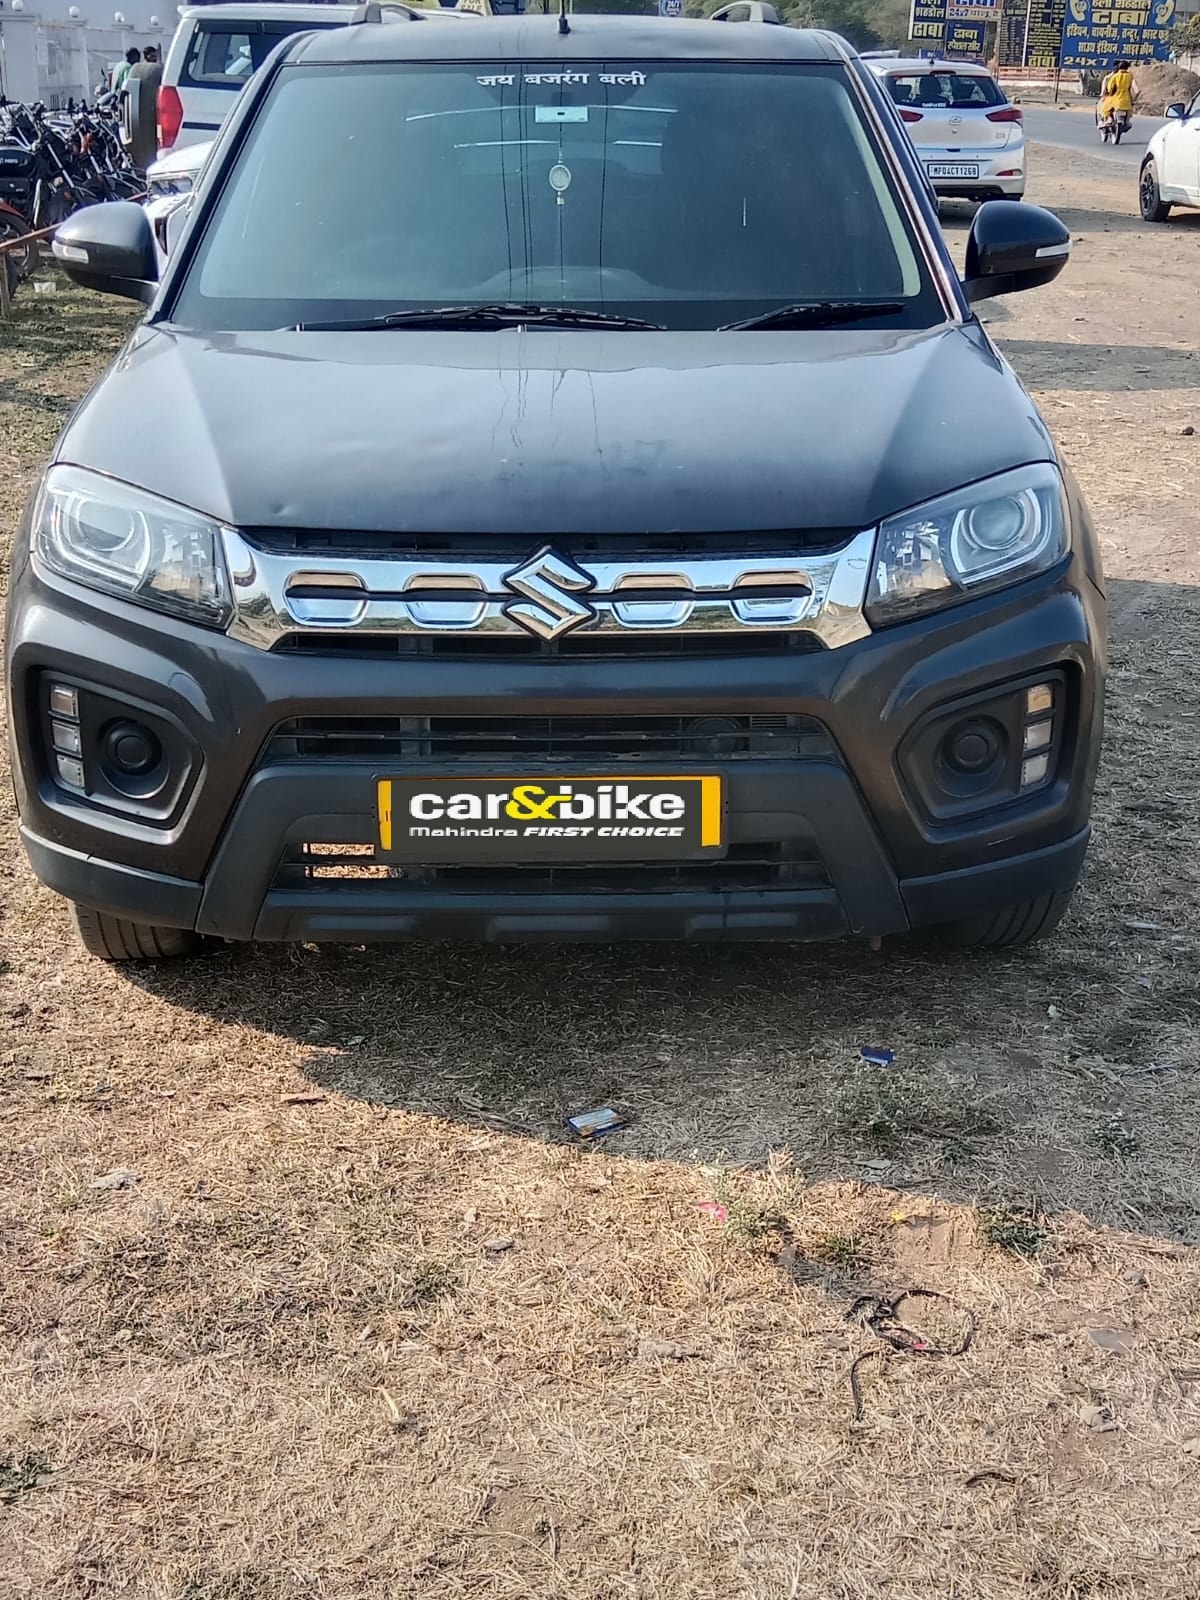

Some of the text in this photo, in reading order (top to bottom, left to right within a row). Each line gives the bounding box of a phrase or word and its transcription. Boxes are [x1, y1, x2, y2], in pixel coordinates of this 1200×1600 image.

[476, 70, 646, 86] जय बजरंग बली
